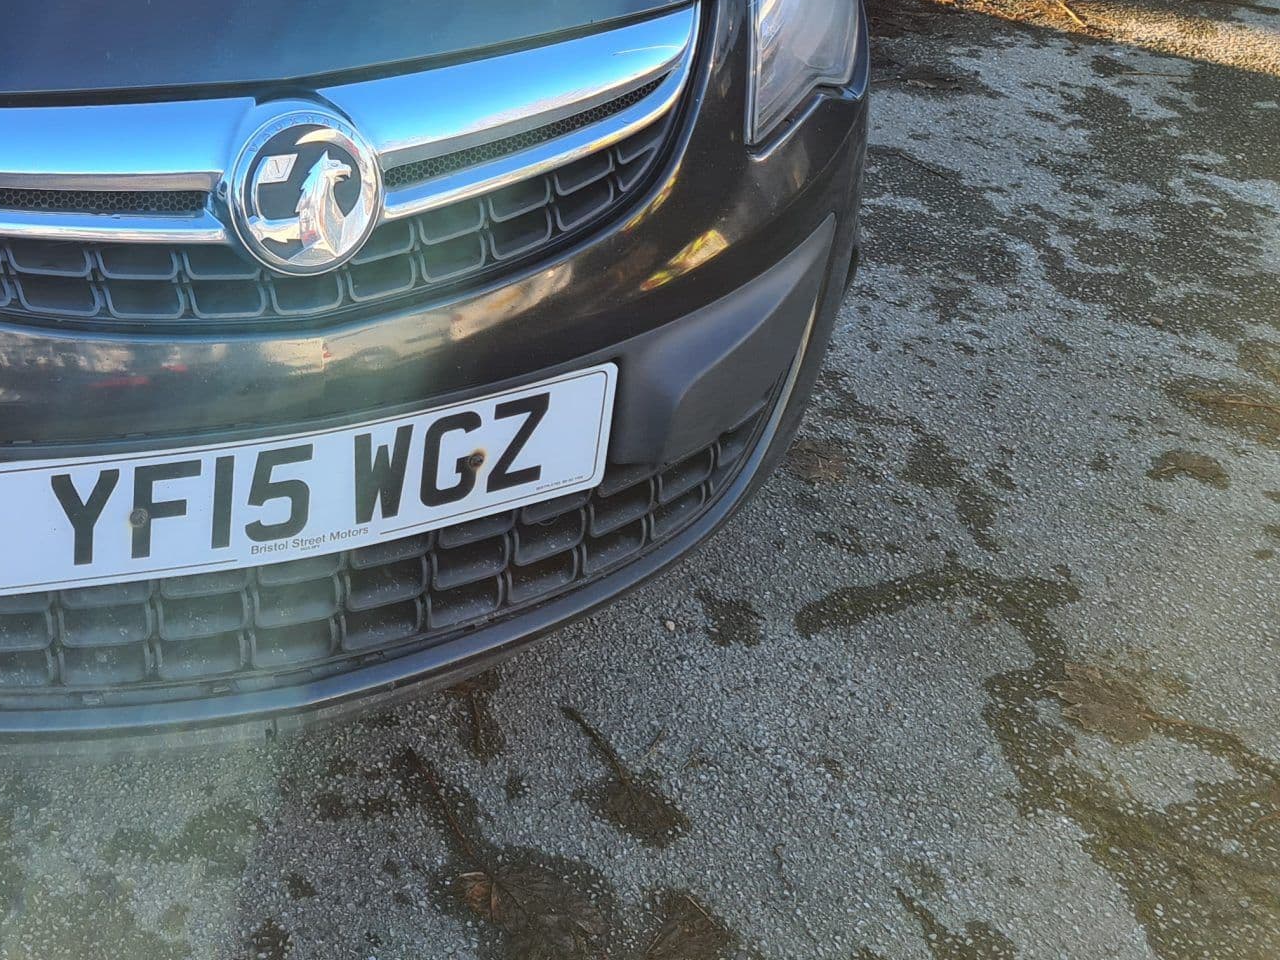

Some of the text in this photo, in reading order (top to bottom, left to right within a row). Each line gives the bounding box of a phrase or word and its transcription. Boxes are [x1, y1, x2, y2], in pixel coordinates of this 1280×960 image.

[50, 392, 551, 566] YF15 WGZ
[250, 541, 288, 555] Bristol
[291, 535, 326, 549] Street
[329, 526, 369, 541] Motors
